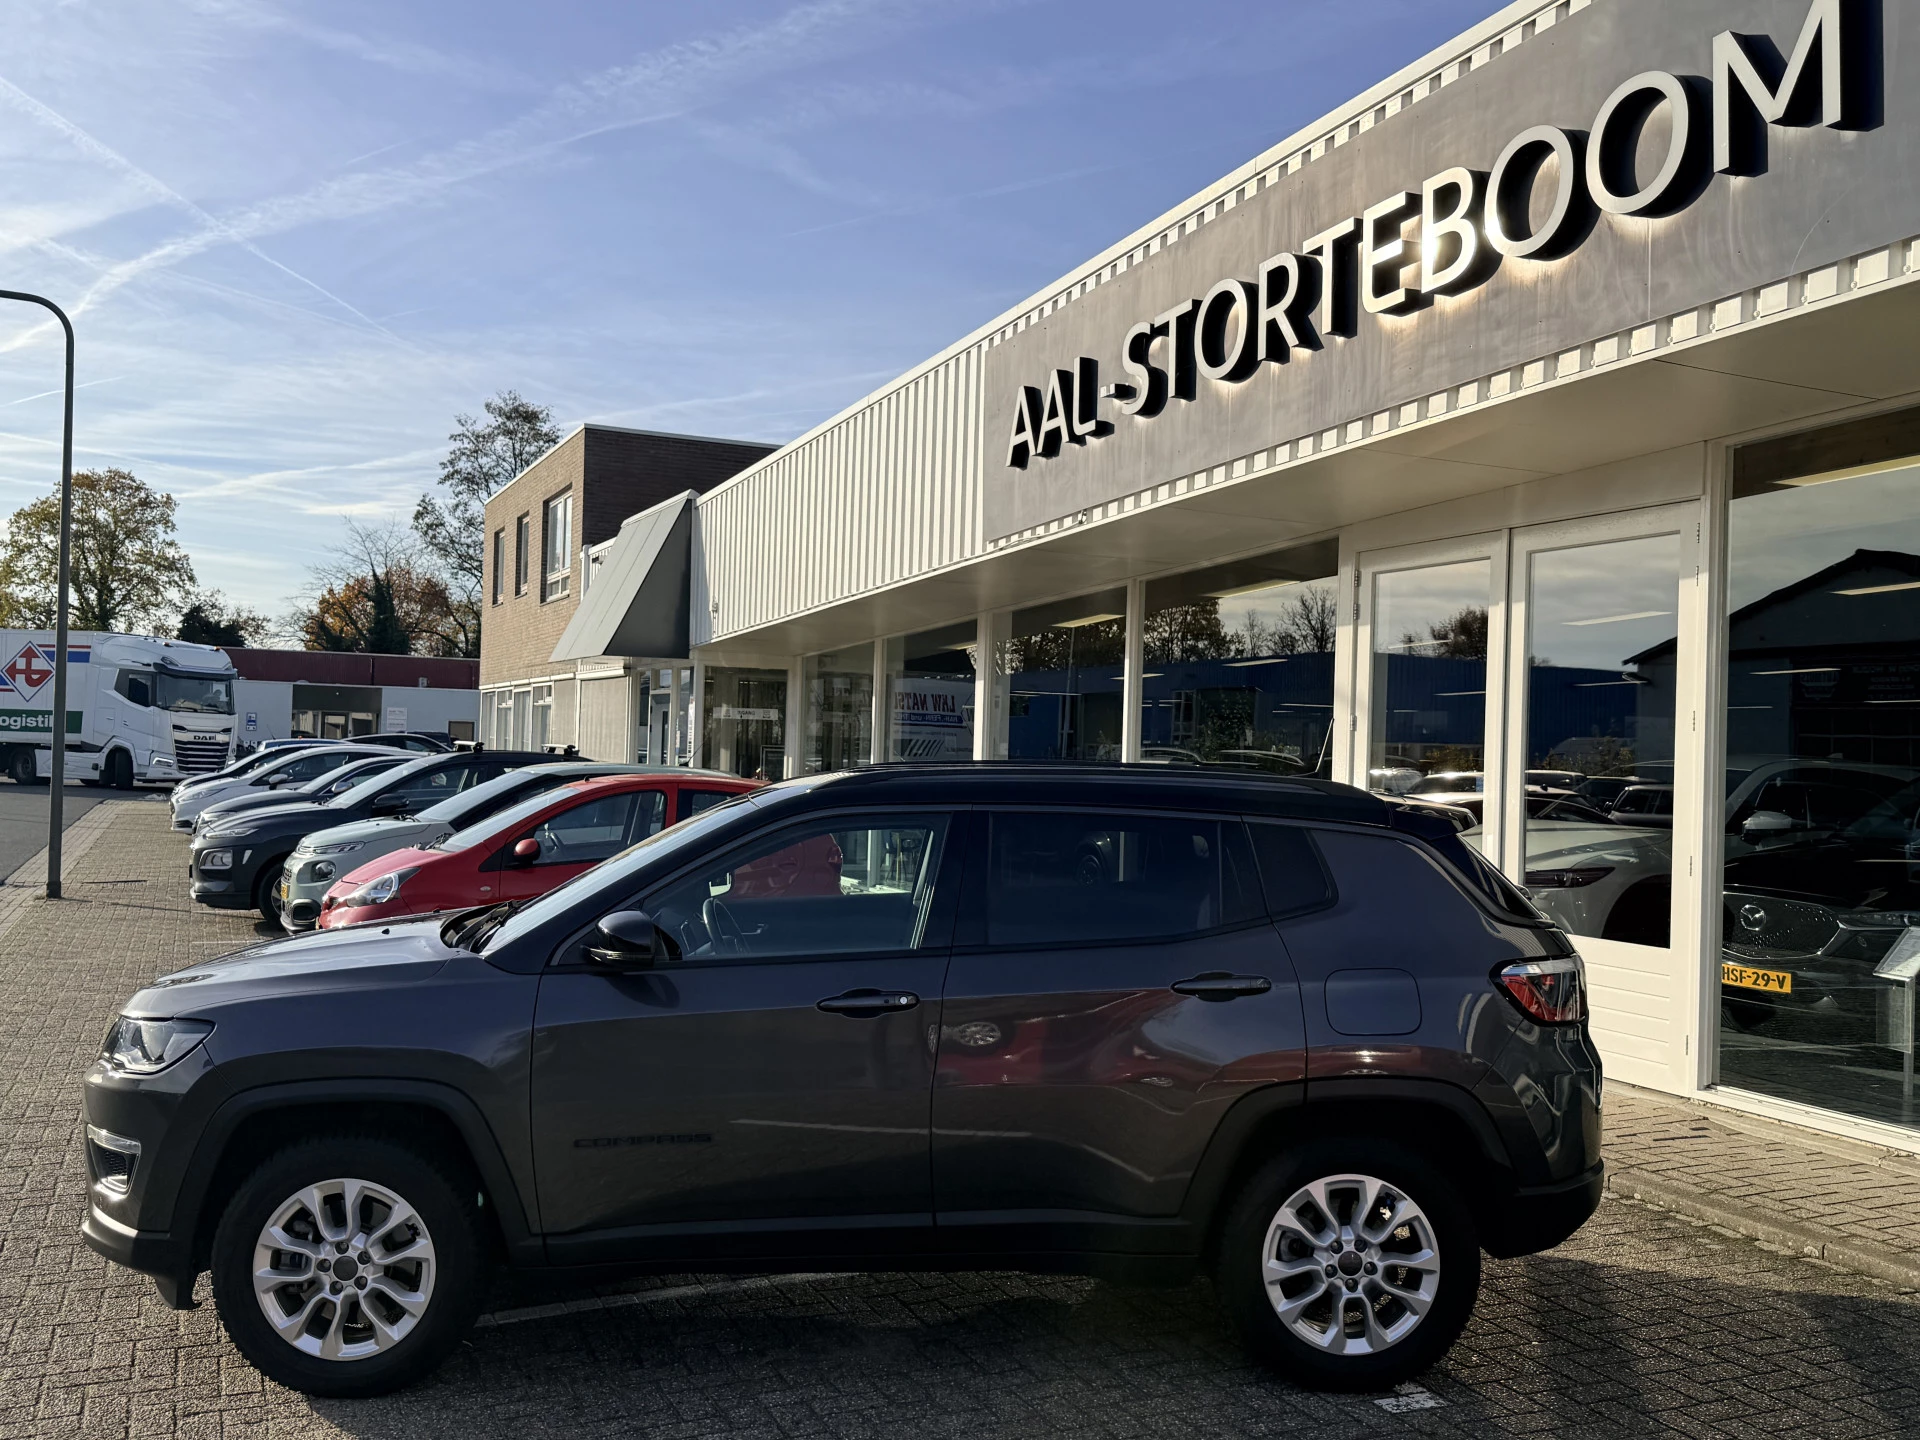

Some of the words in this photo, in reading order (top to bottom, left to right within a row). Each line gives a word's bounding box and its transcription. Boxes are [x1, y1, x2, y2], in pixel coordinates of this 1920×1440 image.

[1005, 0, 1845, 470] AAL-STORTEBOOM
[1722, 966, 1787, 989] HSF-29-V
[573, 1132, 713, 1148] COMPASS
